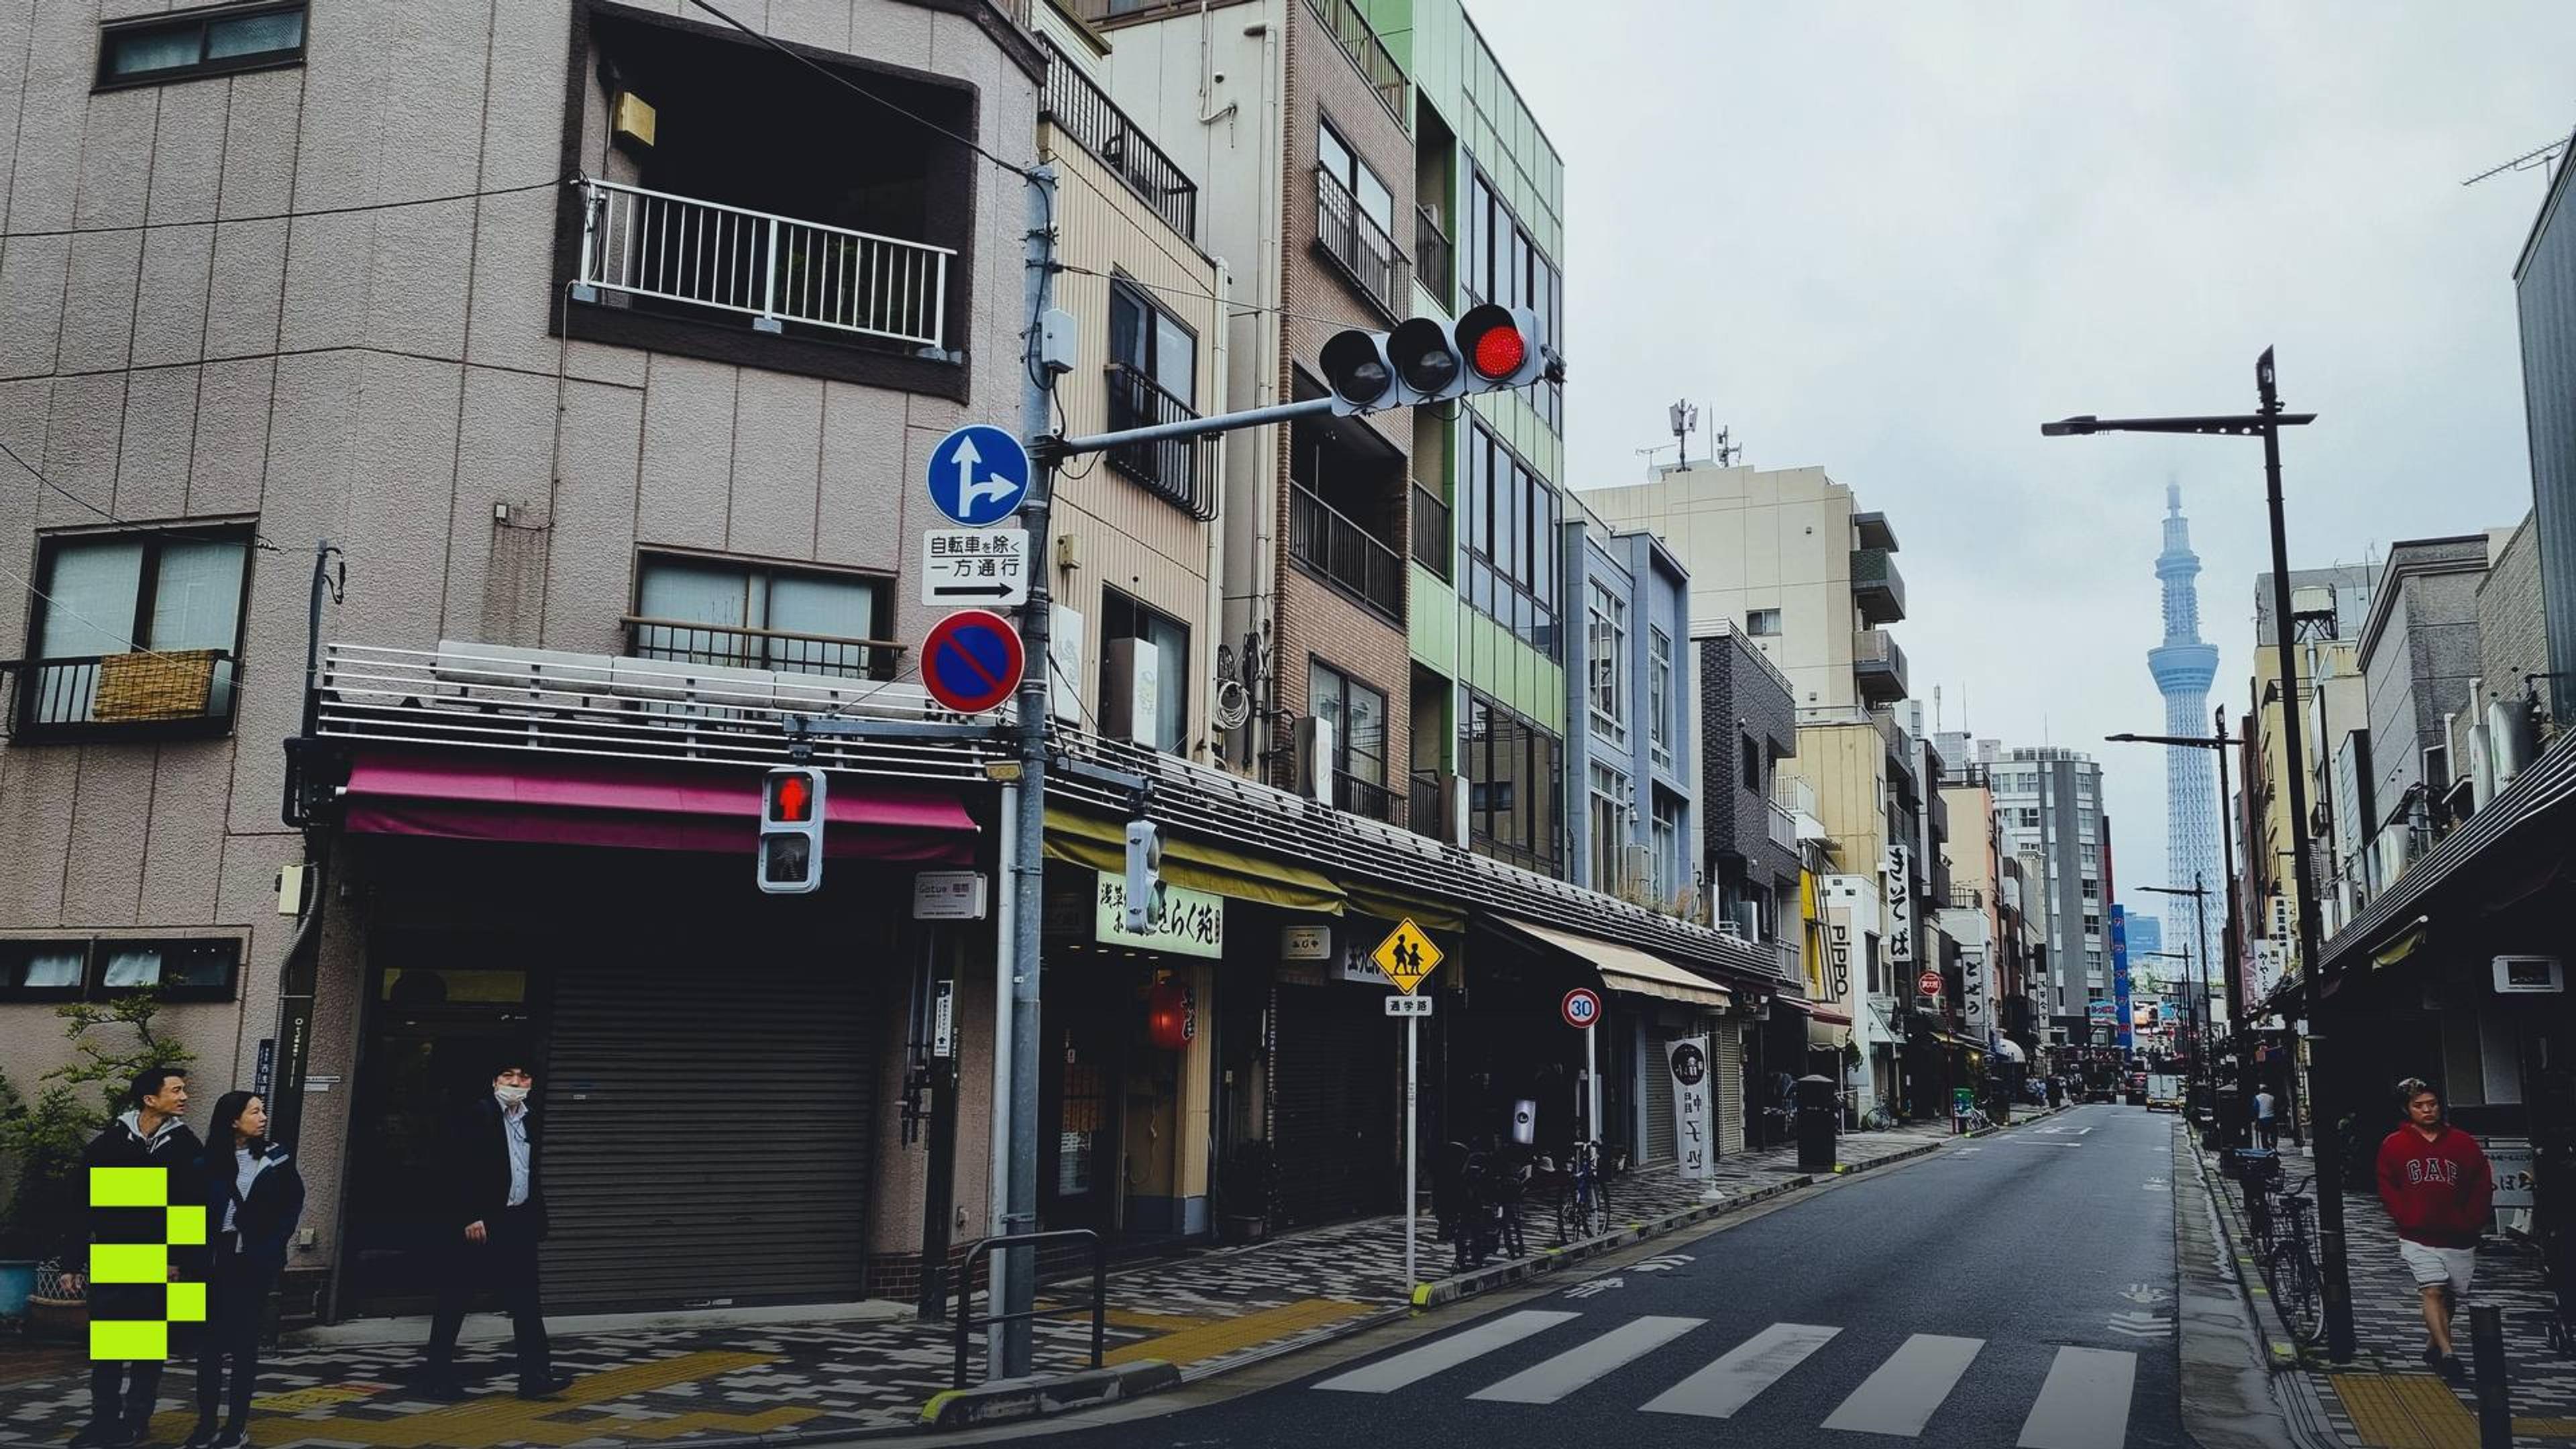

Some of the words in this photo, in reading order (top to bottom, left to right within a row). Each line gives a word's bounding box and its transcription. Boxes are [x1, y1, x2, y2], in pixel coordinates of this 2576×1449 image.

[931, 535, 1020, 554] 自転車を除く
[930, 558, 1020, 578] 一方通行
[1965, 961, 1982, 1015] どぜう
[1390, 1000, 1428, 1012] 通学路
[1571, 1000, 1593, 1016] 30
[2406, 1158, 2459, 1189] GAP
